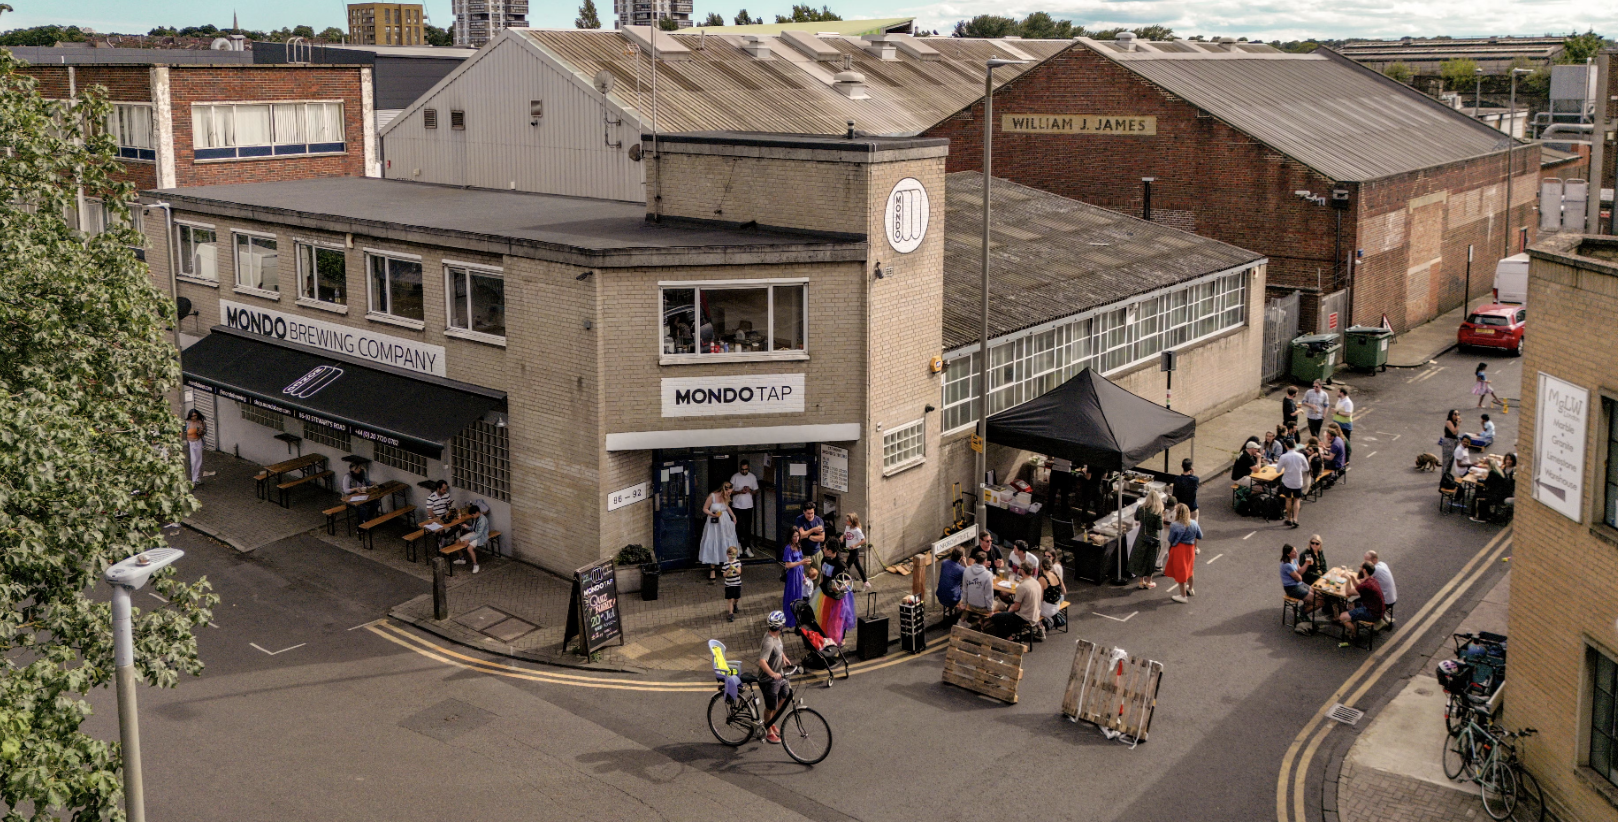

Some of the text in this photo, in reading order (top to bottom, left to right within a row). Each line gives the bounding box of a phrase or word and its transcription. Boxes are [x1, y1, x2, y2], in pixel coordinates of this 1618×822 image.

[1012, 118, 1146, 132] WILLIAM J. JAMES
[226, 305, 437, 373] MONDO BREWING COMPANY
[1552, 417, 1576, 436] Marble
[1551, 435, 1574, 453] Granite
[1546, 450, 1578, 473] Limestone
[1544, 467, 1578, 492] Warehouse
